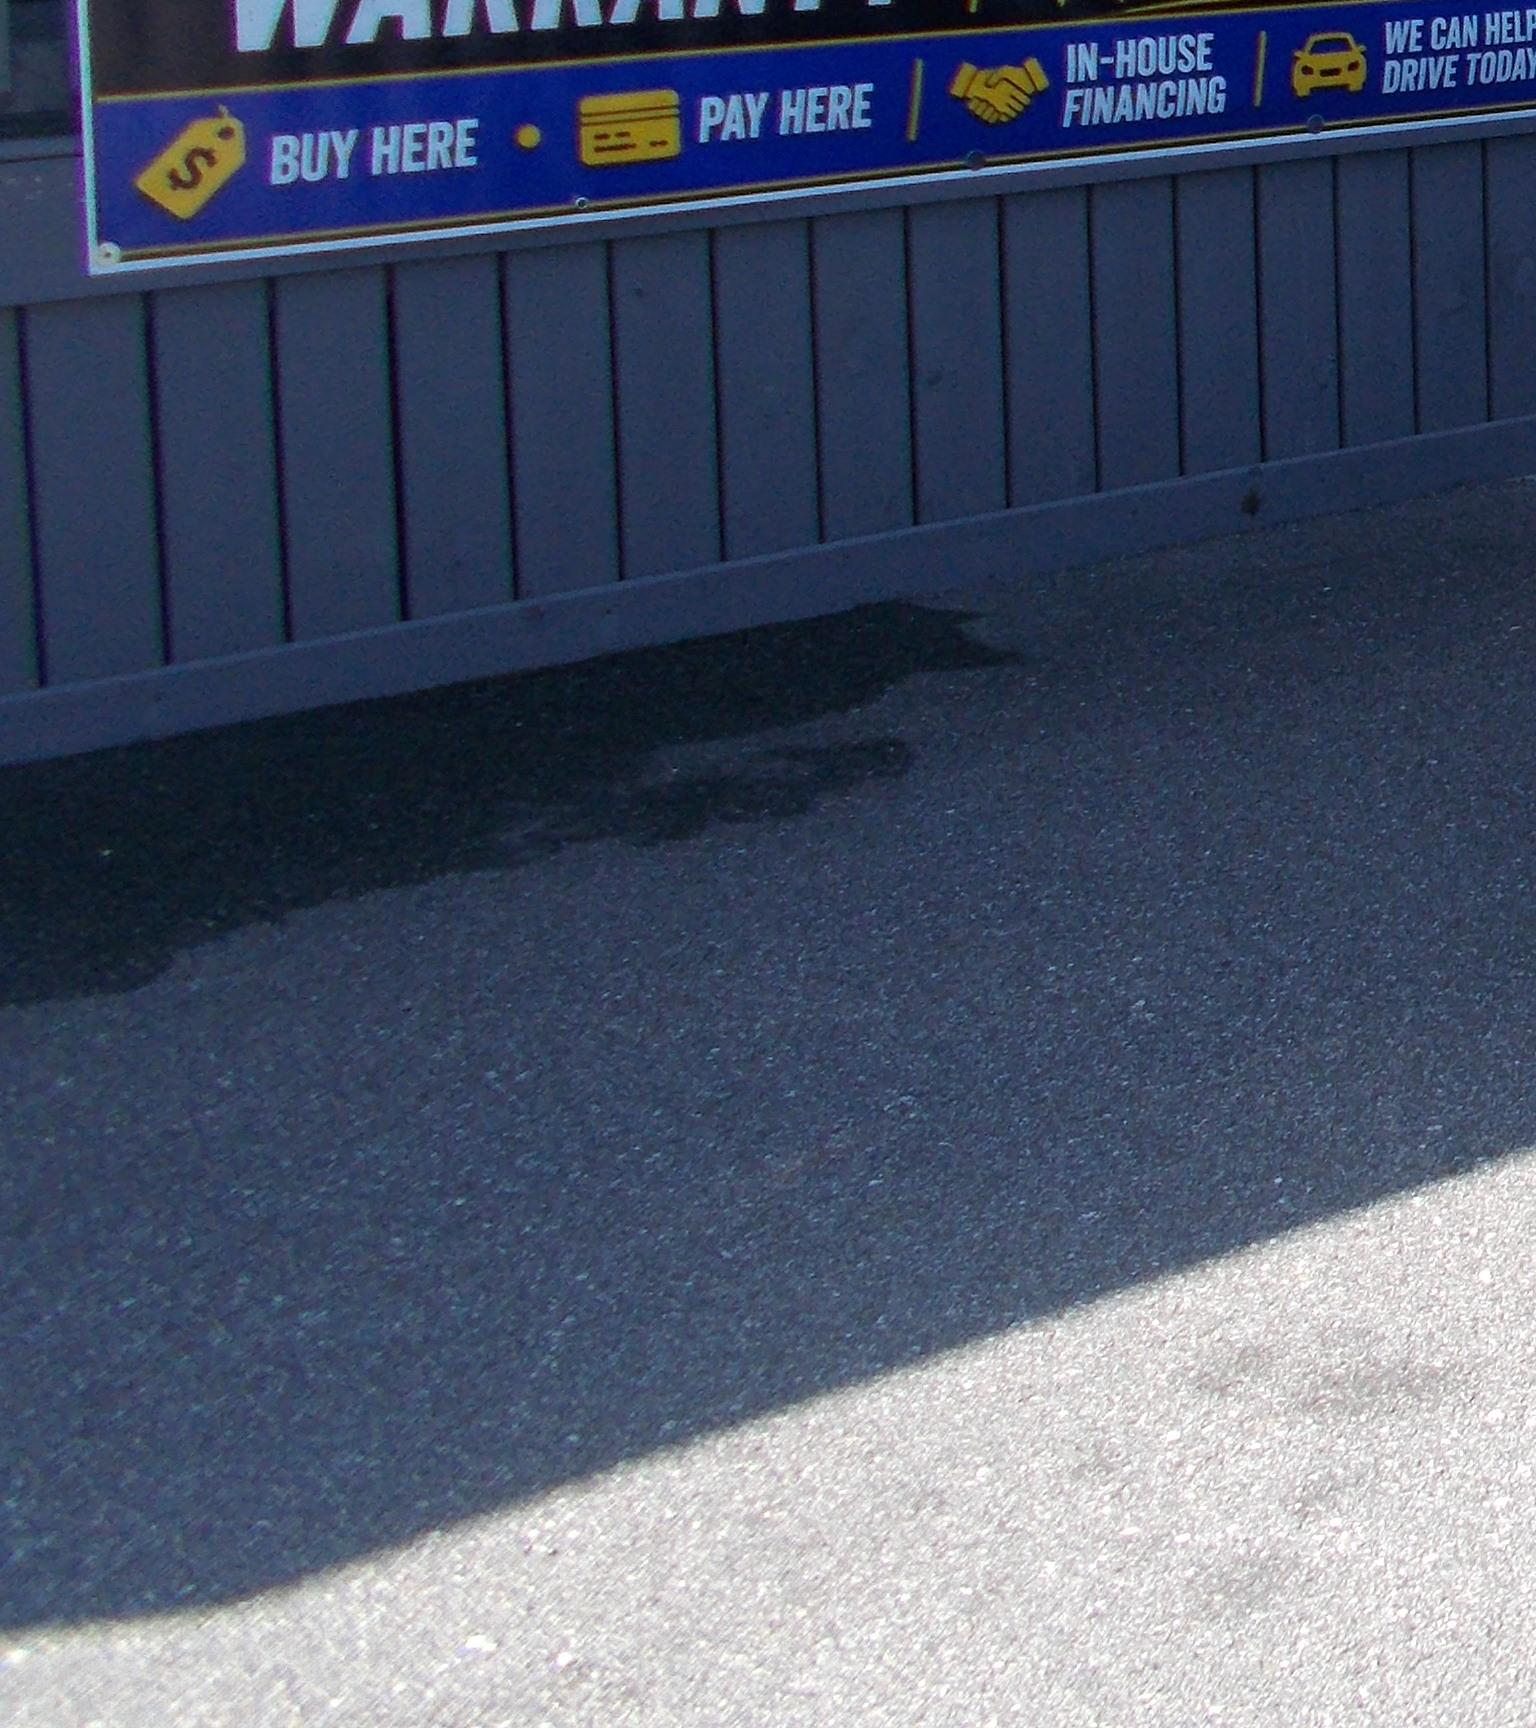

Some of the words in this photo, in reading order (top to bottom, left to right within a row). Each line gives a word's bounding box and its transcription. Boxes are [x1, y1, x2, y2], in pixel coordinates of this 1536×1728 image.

[1066, 32, 1215, 84] IN-HOUSE
[1383, 20, 1421, 54] WE
[1430, 15, 1478, 49] CAN
[1062, 75, 1228, 128] FINANCING
[1381, 58, 1457, 95] DRIVE
[699, 89, 770, 144] PAY
[779, 82, 875, 136] HERE
[270, 127, 359, 185] BUY
[371, 118, 480, 175] HERE
